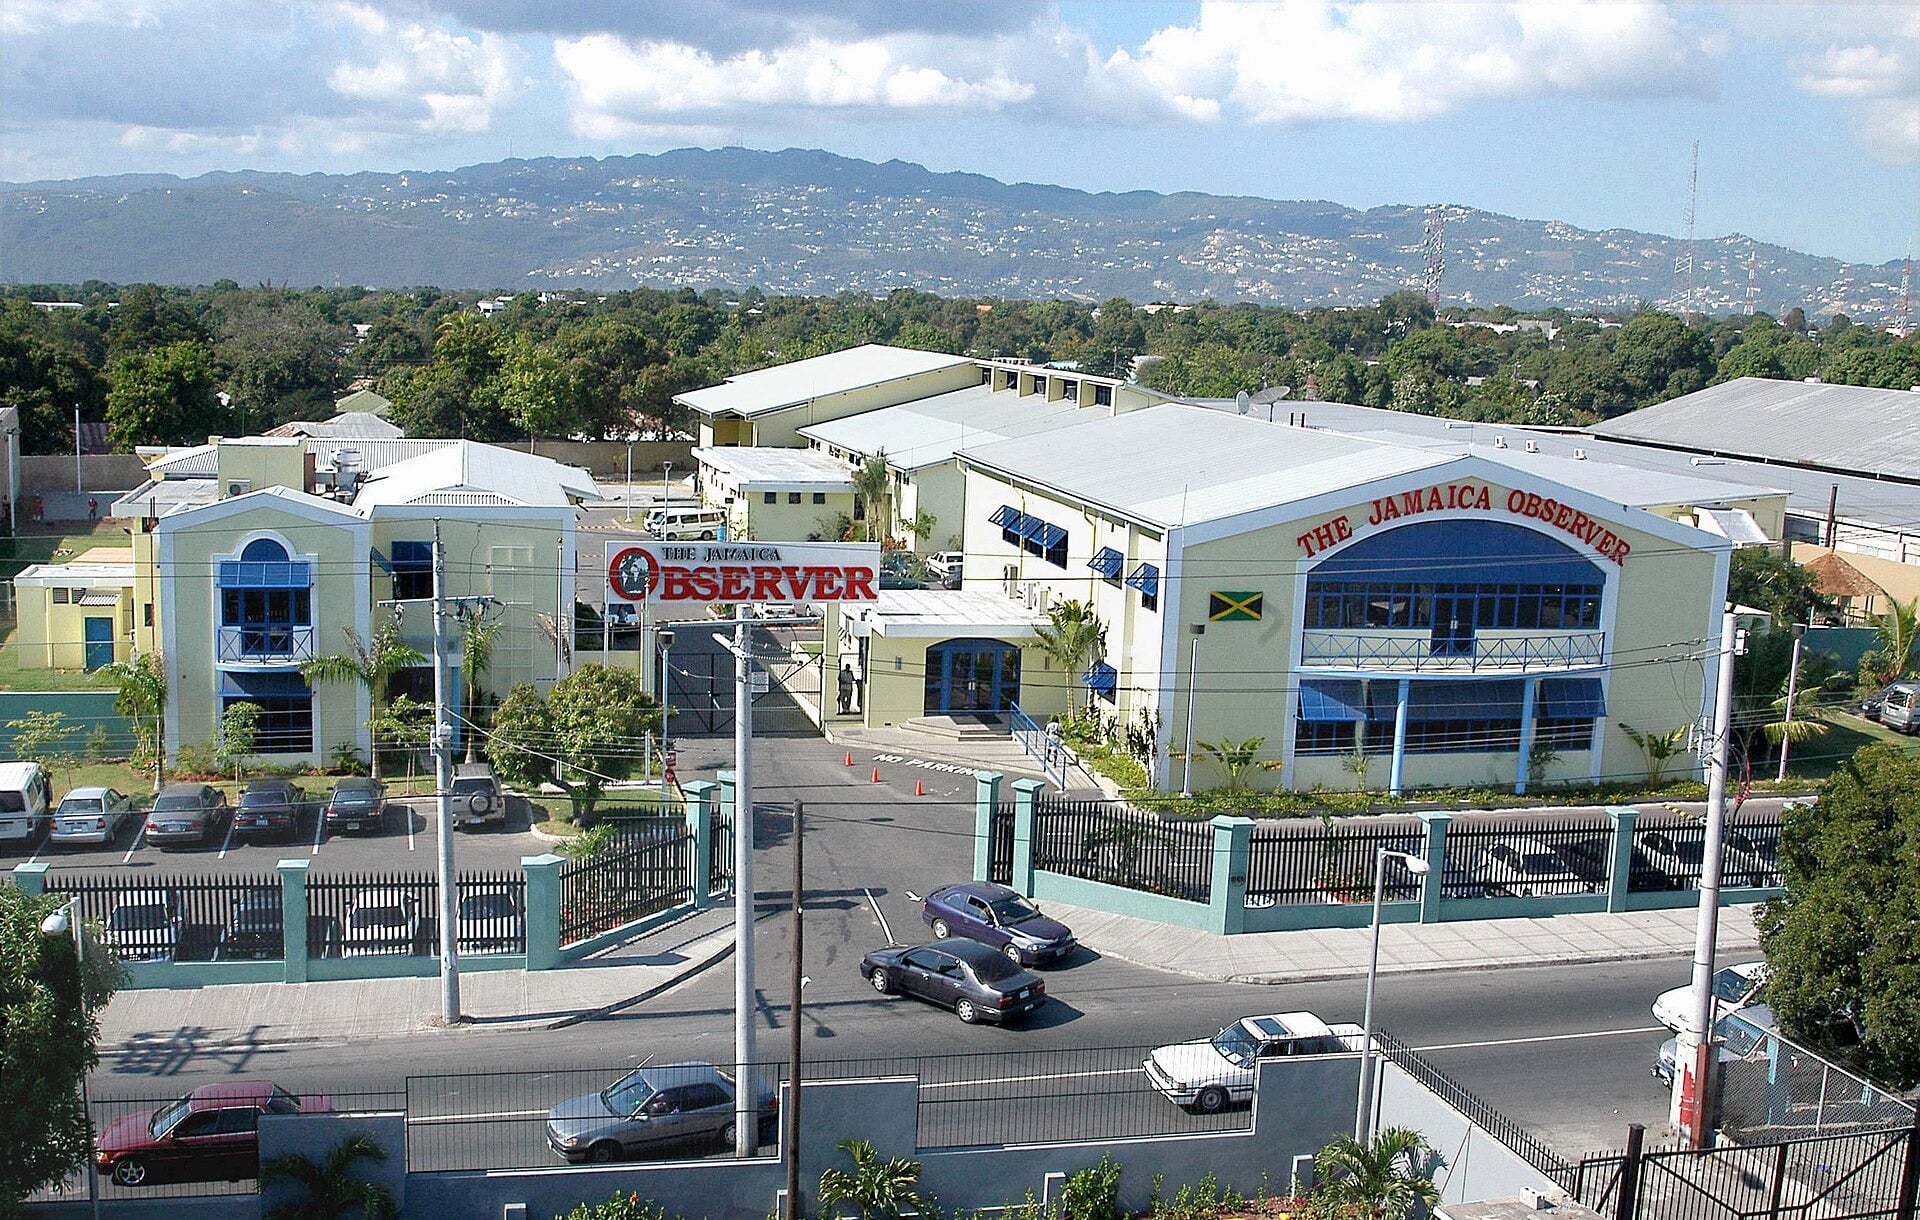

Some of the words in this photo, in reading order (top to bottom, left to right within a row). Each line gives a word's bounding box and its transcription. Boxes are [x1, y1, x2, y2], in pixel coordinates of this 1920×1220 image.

[1297, 515, 1353, 558] THE
[1368, 485, 1492, 526] JAMAICA
[1508, 490, 1631, 567] OBSERVER
[662, 547, 696, 561] THE
[703, 548, 783, 562] JAMAICA
[608, 547, 878, 601] OBSERVER
[872, 754, 904, 763] NO
[905, 759, 978, 776] PARKIN
